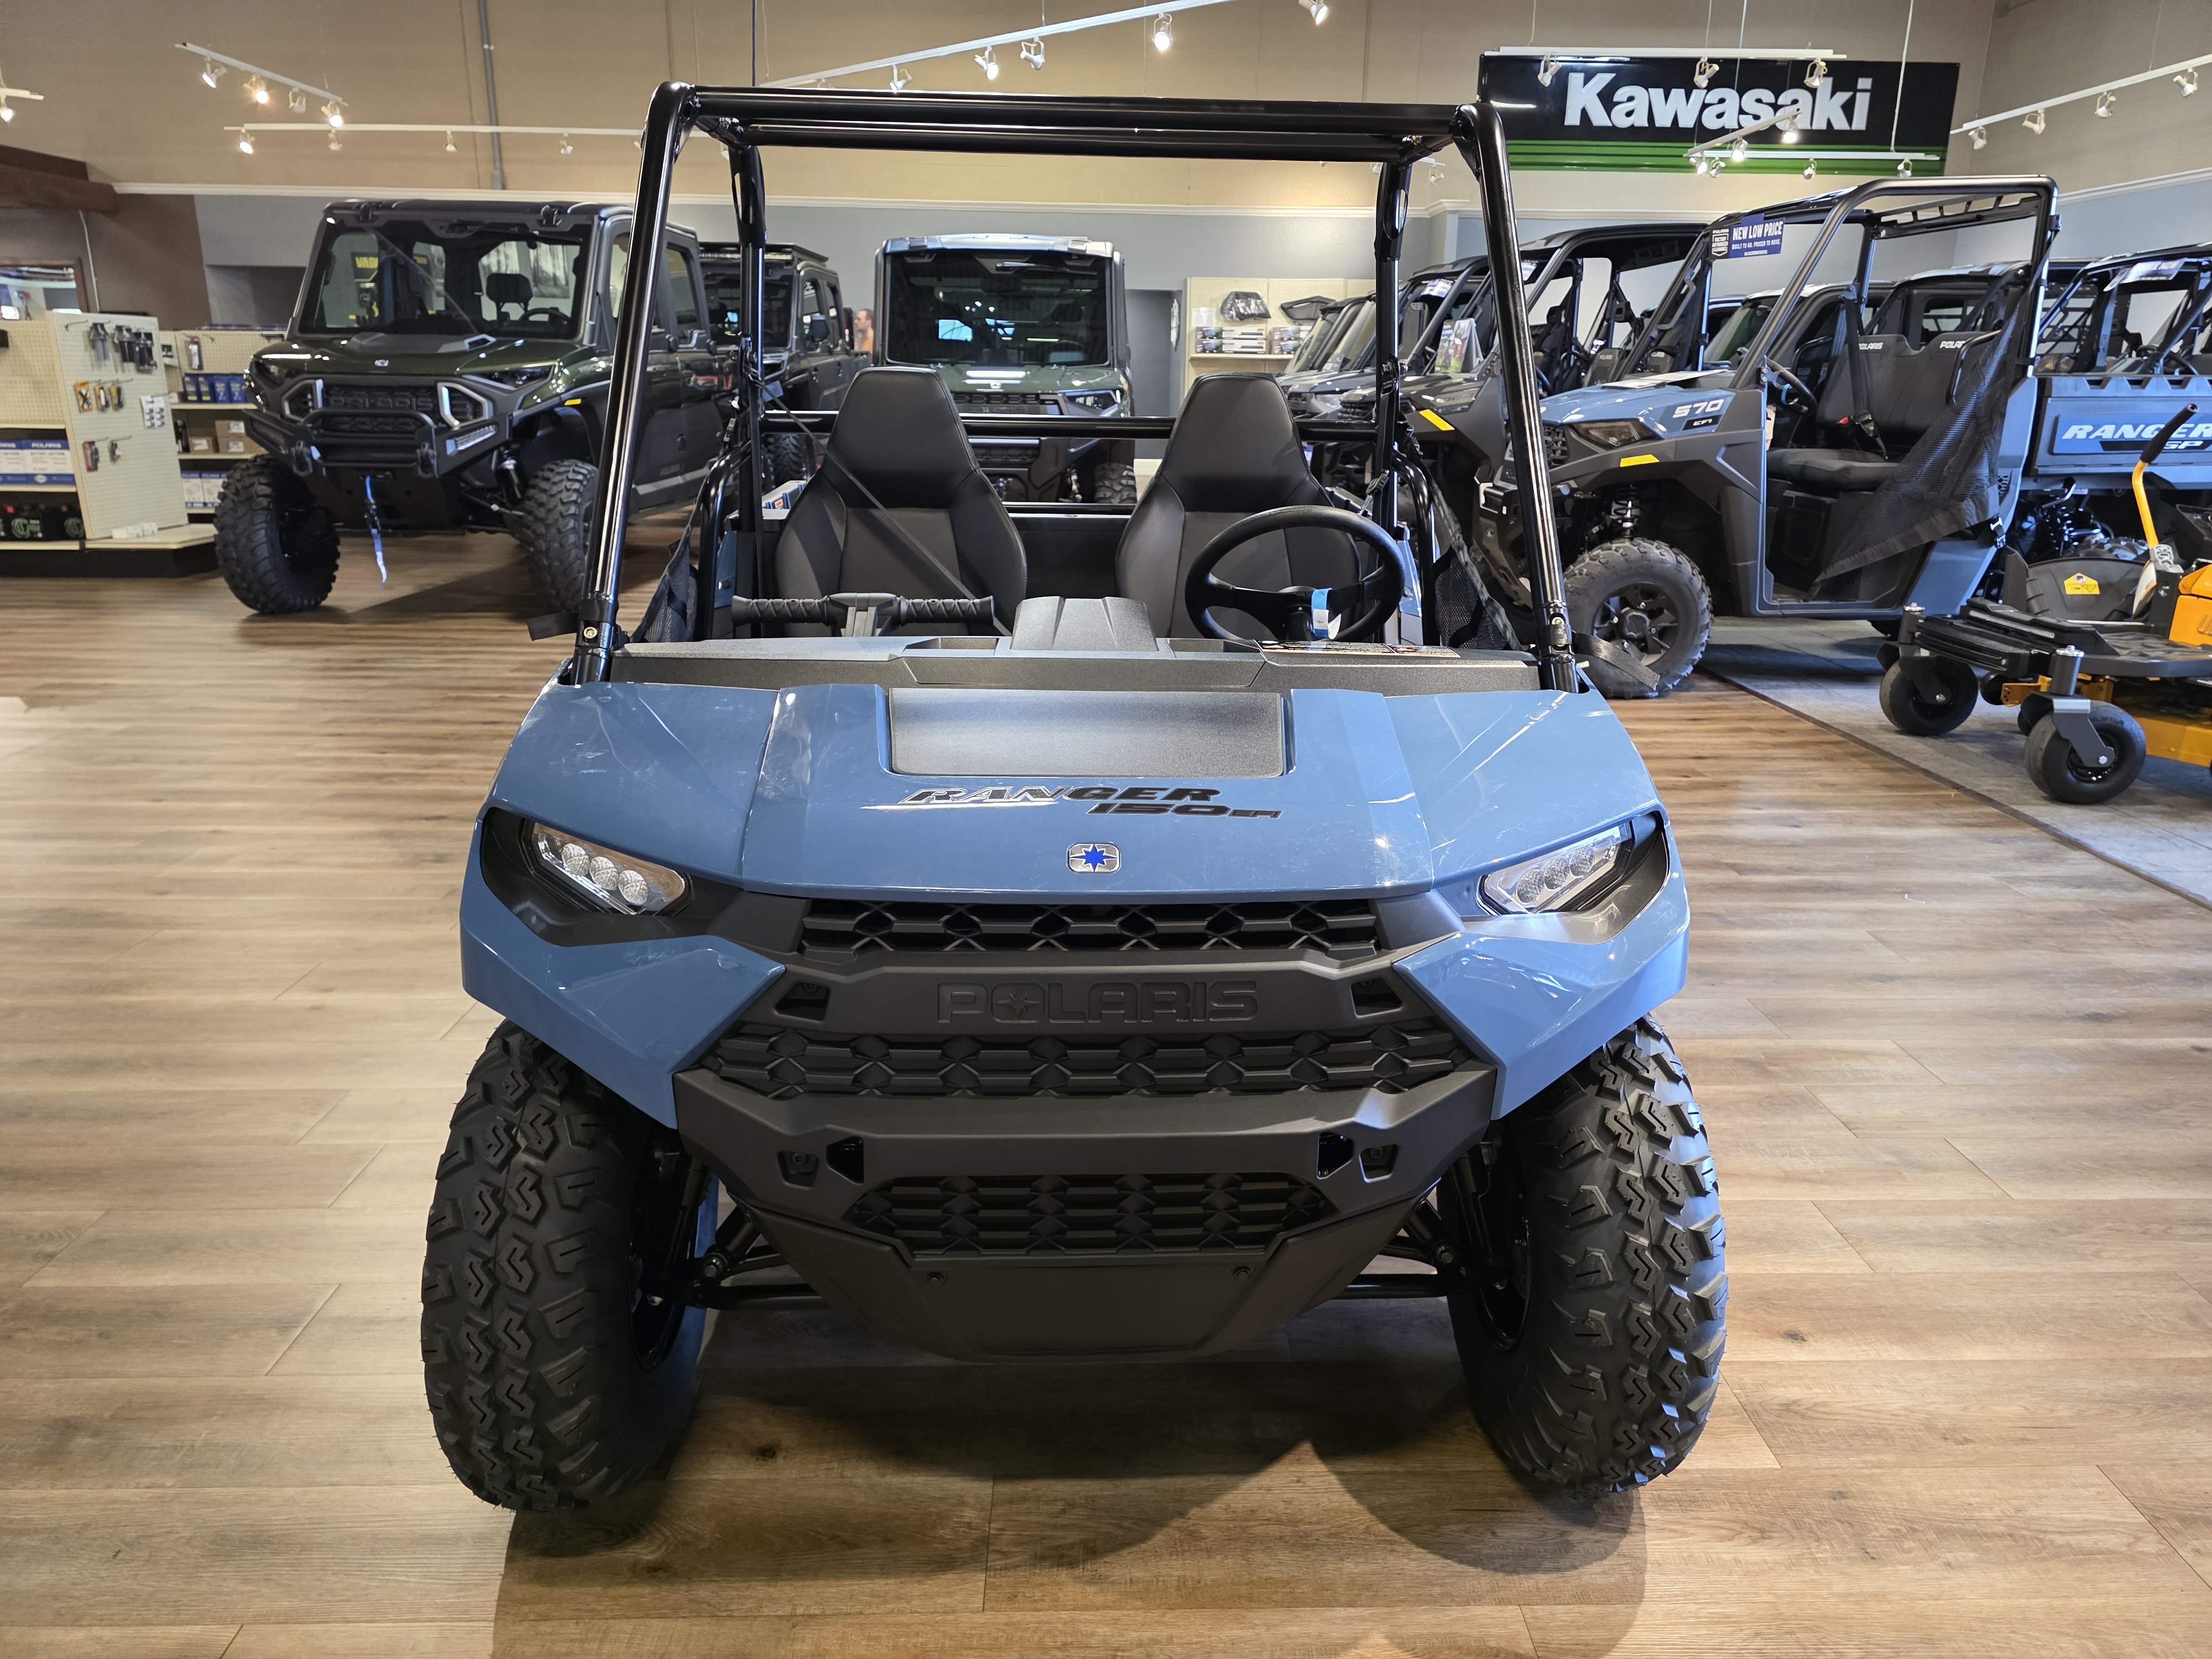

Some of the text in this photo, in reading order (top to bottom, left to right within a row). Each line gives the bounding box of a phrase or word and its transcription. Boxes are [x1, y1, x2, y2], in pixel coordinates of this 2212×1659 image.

[1564, 72, 1873, 131] Kawasaki
[1733, 221, 1783, 241] NEW LOW PRICE
[1673, 399, 1724, 418] 570
[898, 786, 1223, 805] RANGER
[1087, 803, 1284, 820] 150 EFI
[937, 981, 1258, 1023] POLARIS
